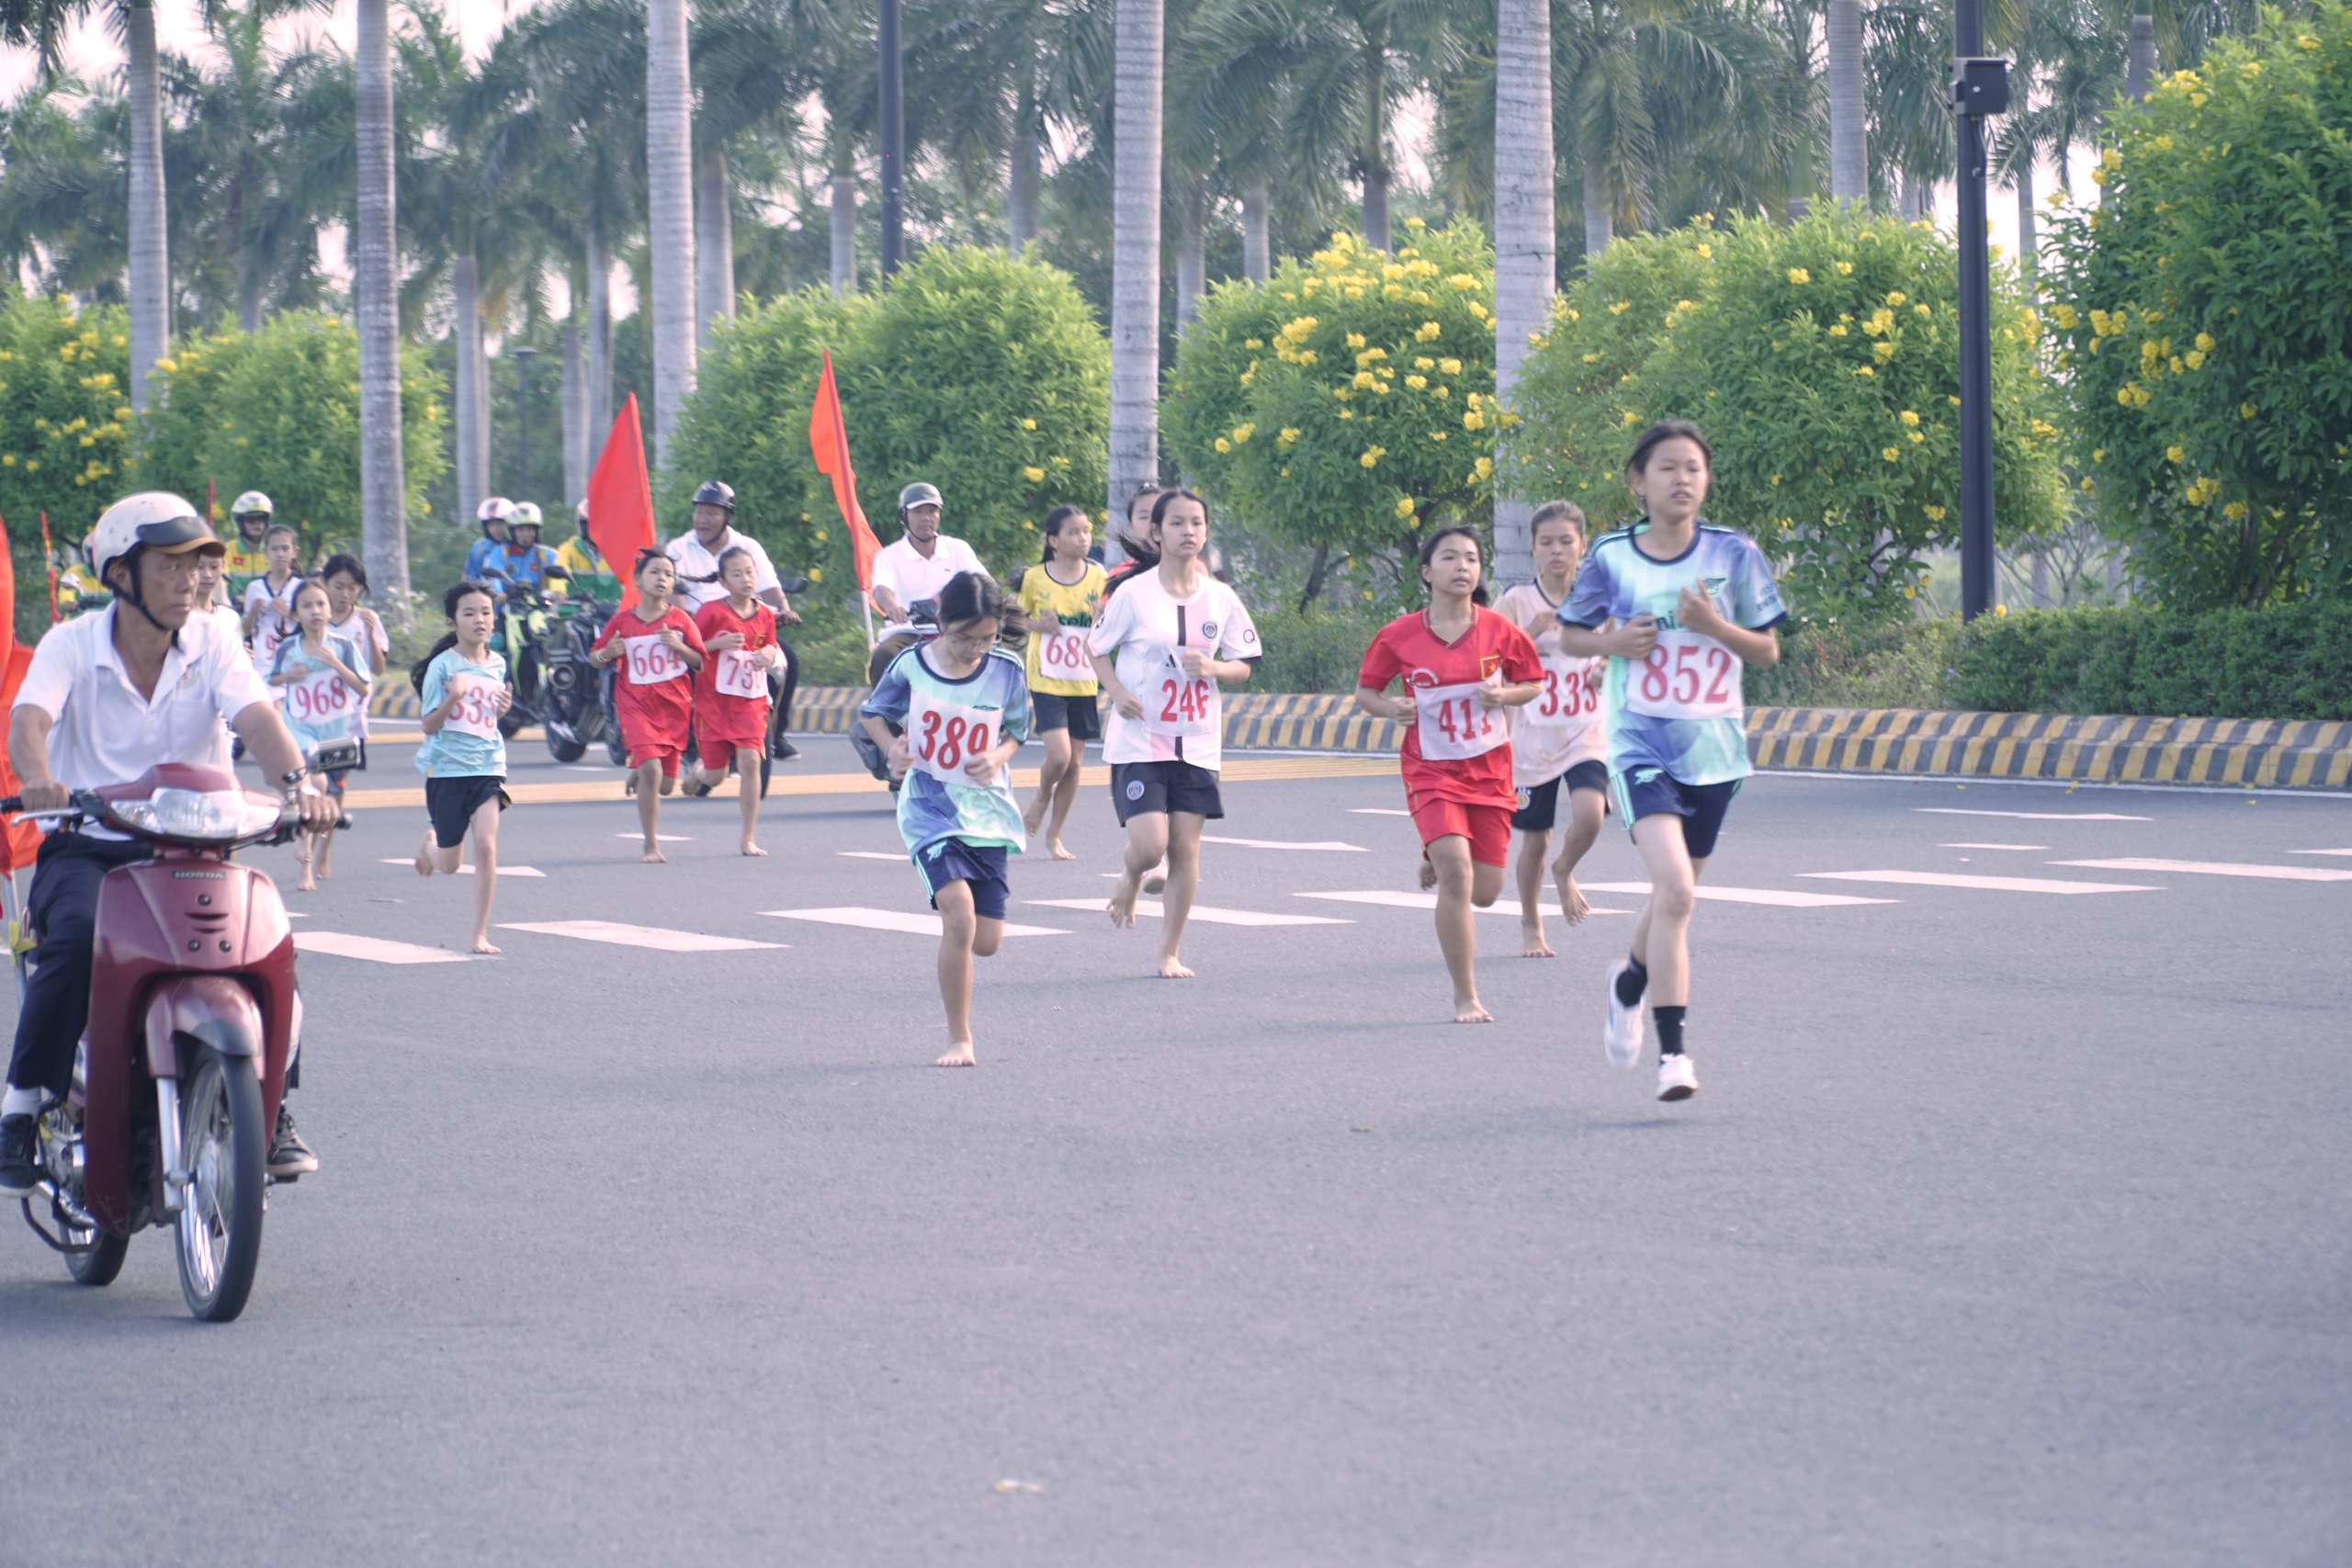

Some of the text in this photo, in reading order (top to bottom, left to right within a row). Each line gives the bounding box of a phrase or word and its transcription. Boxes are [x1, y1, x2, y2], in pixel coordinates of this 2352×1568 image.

[1243, 629, 1257, 644] Q
[633, 642, 682, 677] 664
[1641, 644, 1732, 705] 852
[296, 676, 346, 720] 968
[1539, 666, 1598, 717] 335
[174, 871, 225, 880] HONDA
